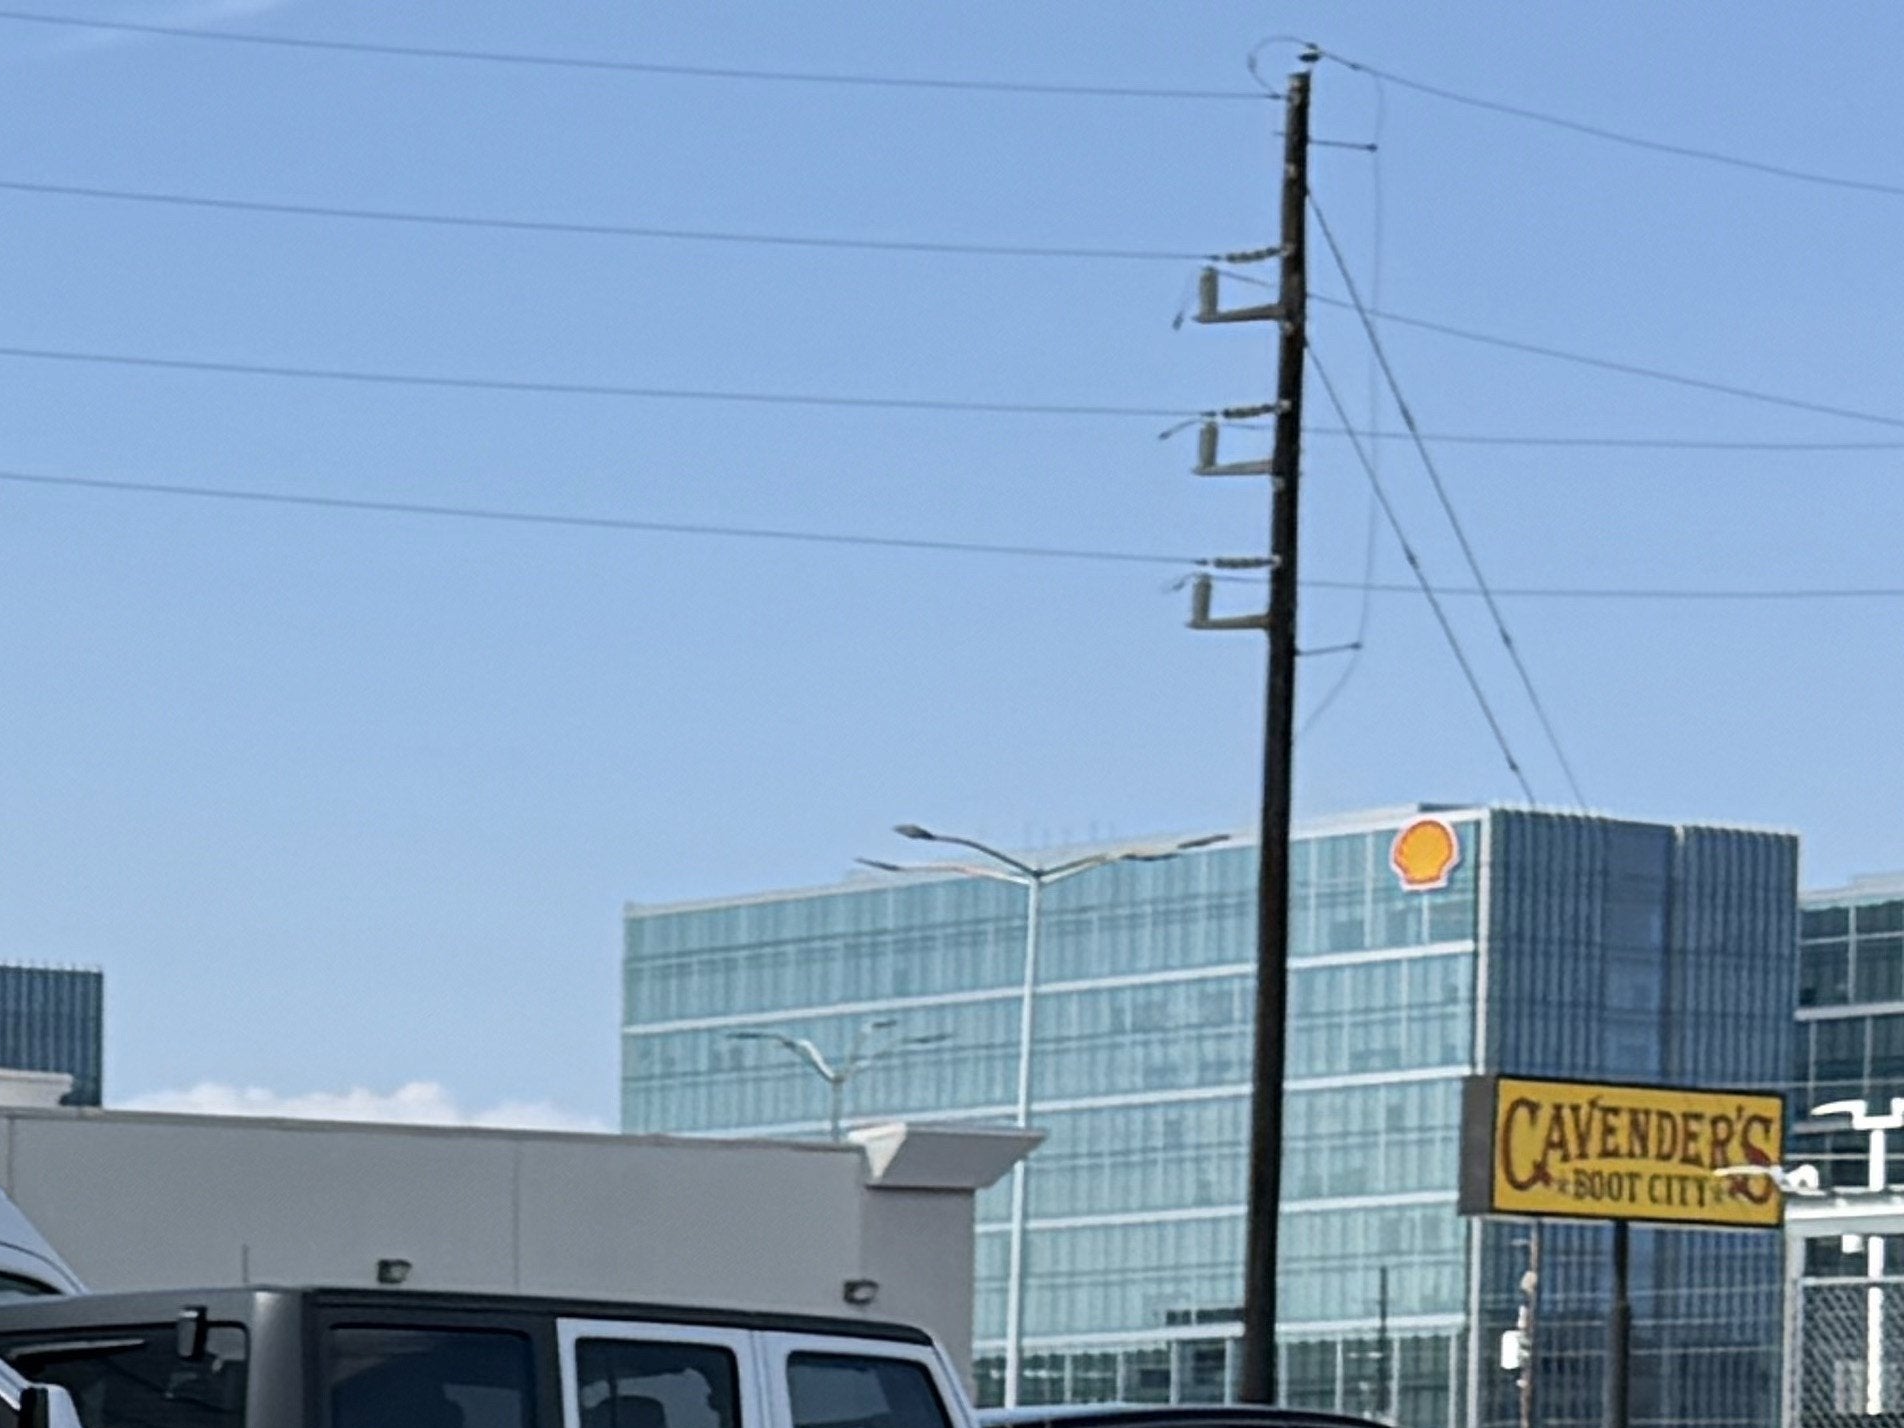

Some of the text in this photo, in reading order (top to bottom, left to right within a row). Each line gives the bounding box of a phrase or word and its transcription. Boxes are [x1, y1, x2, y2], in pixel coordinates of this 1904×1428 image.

[1504, 1095, 1773, 1204] CAVENDER'S
[1572, 1168, 1710, 1209] BOOT CITY
